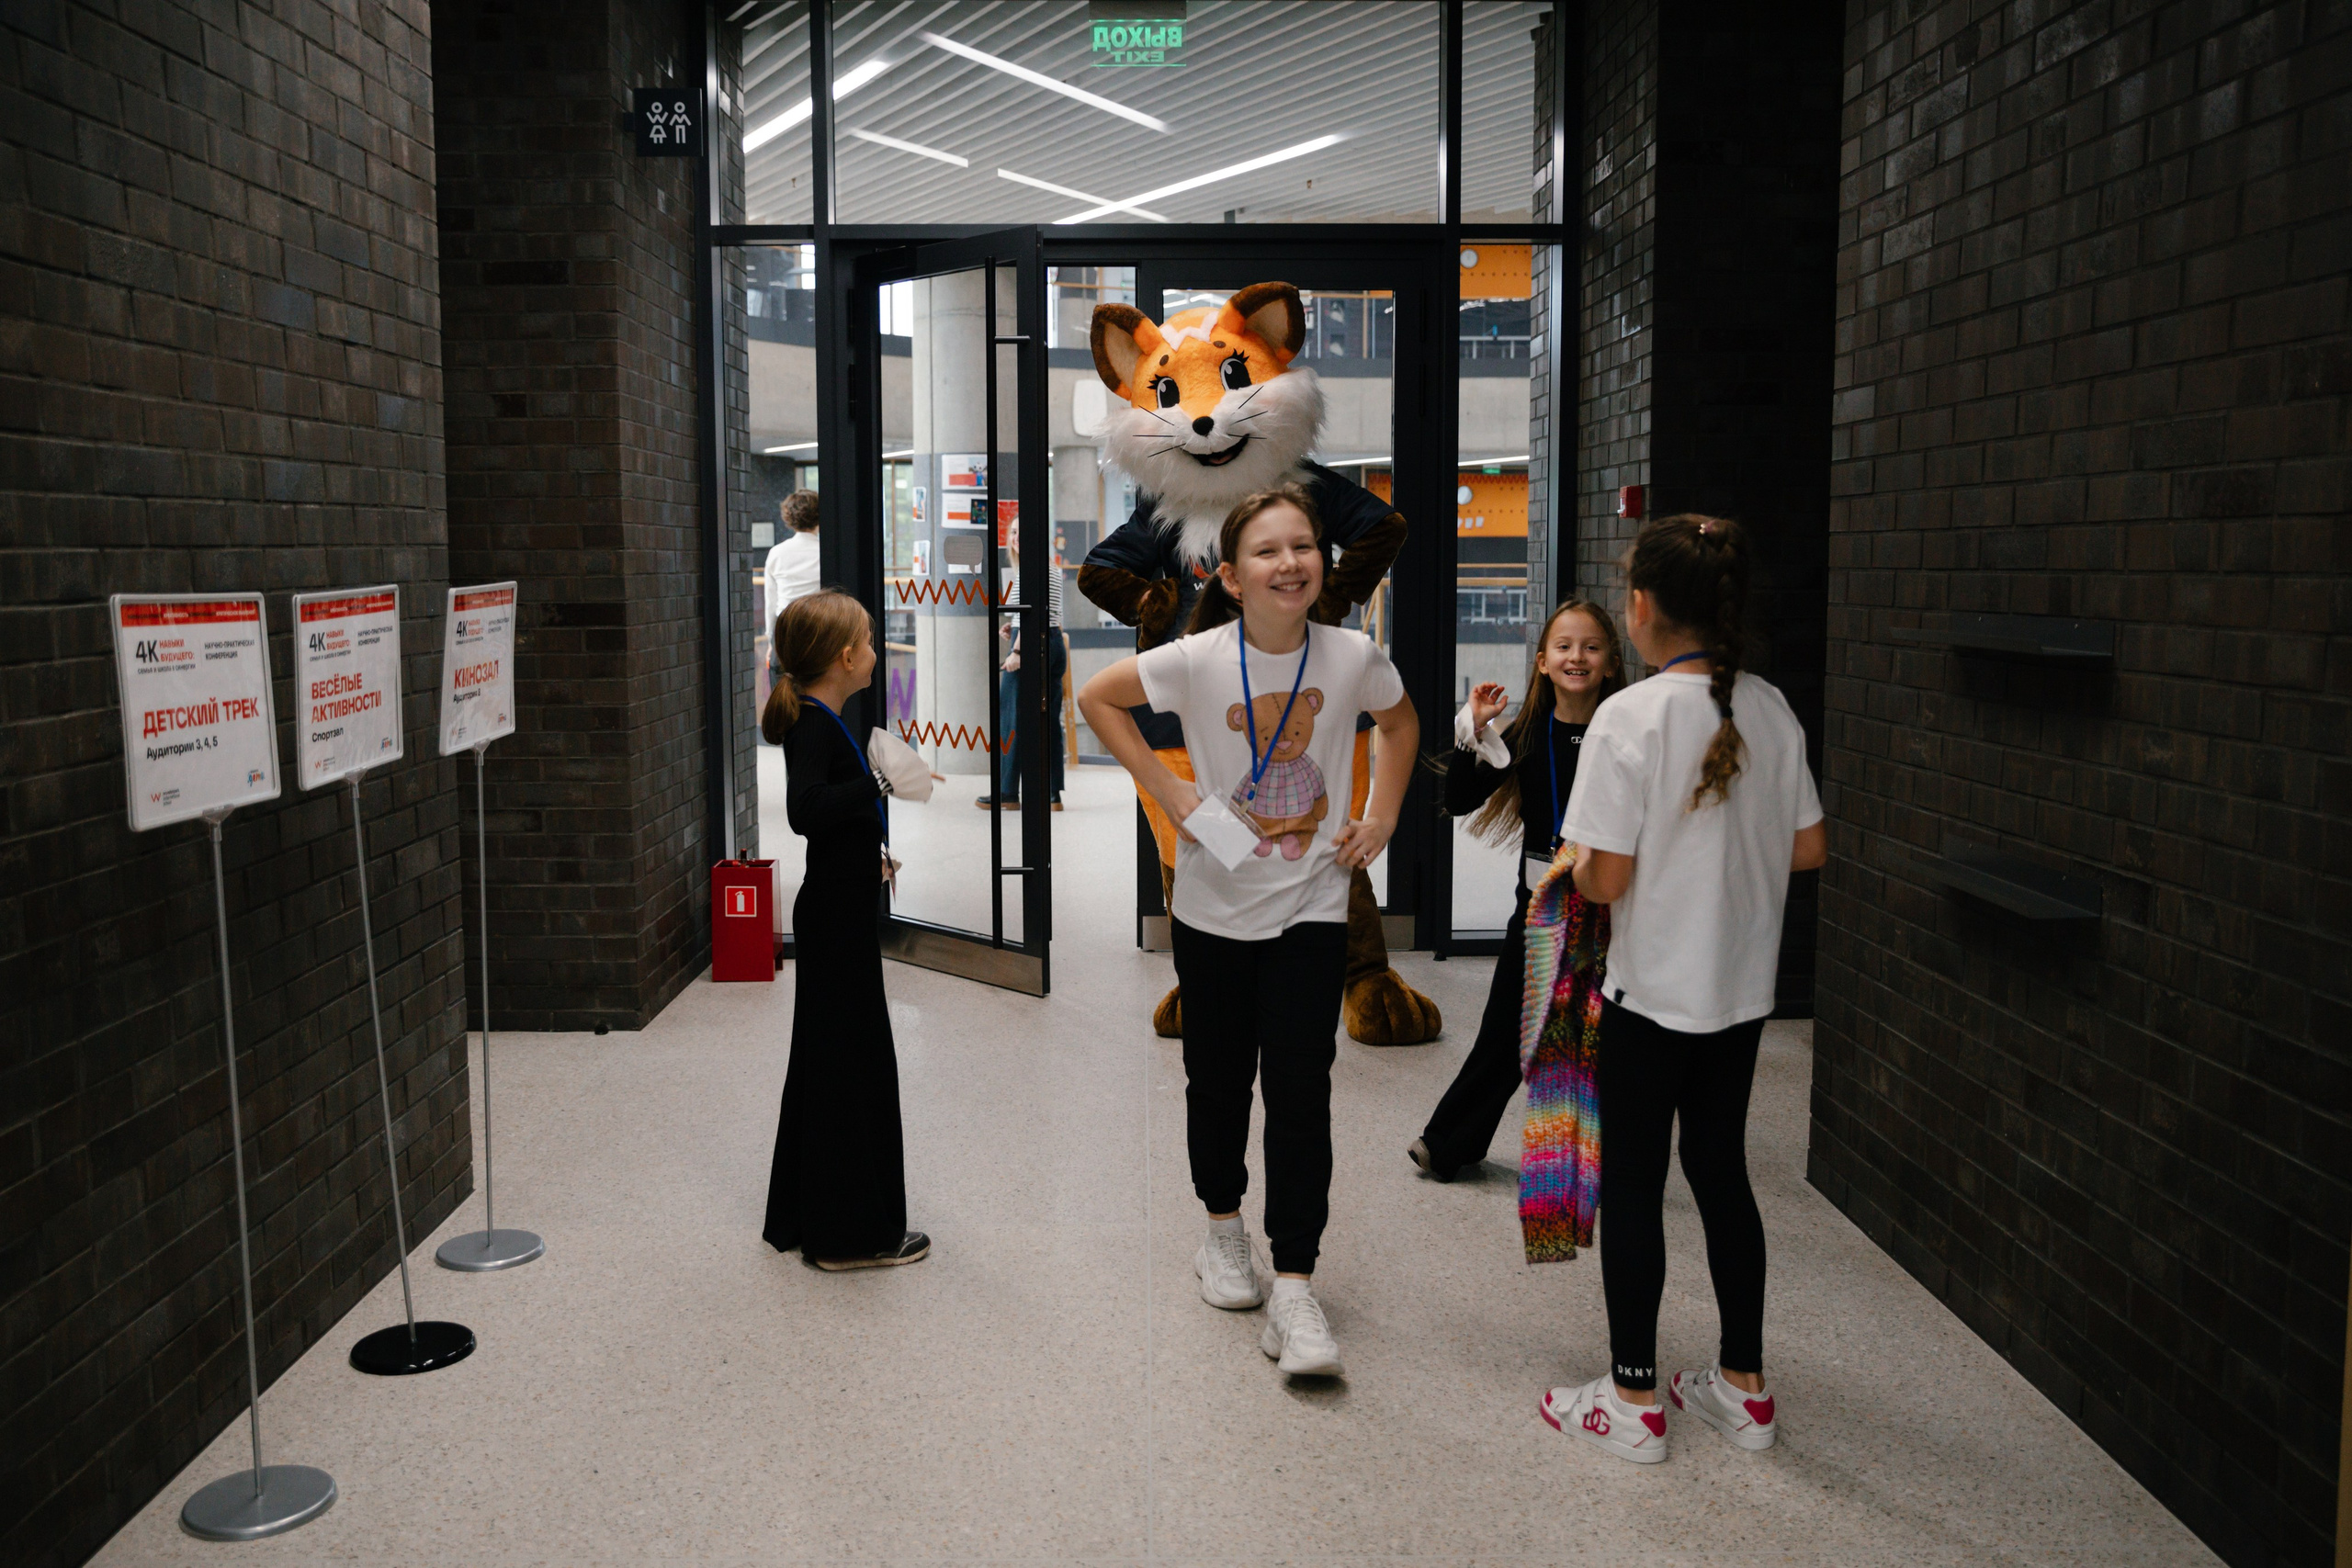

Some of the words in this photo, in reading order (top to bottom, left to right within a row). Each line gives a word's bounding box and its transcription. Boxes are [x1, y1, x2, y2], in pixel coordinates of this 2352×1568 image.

[159, 639, 185, 649] НАВЫКИ
[160, 651, 195, 662] БУДУЩЕГО:
[311, 672, 362, 700] ВЕСЁЛЫЕ
[454, 660, 499, 690] КИНОЗАЛ
[142, 697, 220, 739] ДЕТСКИЙ
[222, 697, 259, 722] ТРЕК
[311, 690, 382, 724] АКТИВНОСТИ
[311, 727, 344, 742] Спортзал
[147, 741, 194, 761] Аудитории
[196, 739, 203, 751] 3,
[204, 737, 211, 750] 4,
[212, 736, 219, 747] 5
[1617, 1364, 1653, 1377] DKNY
